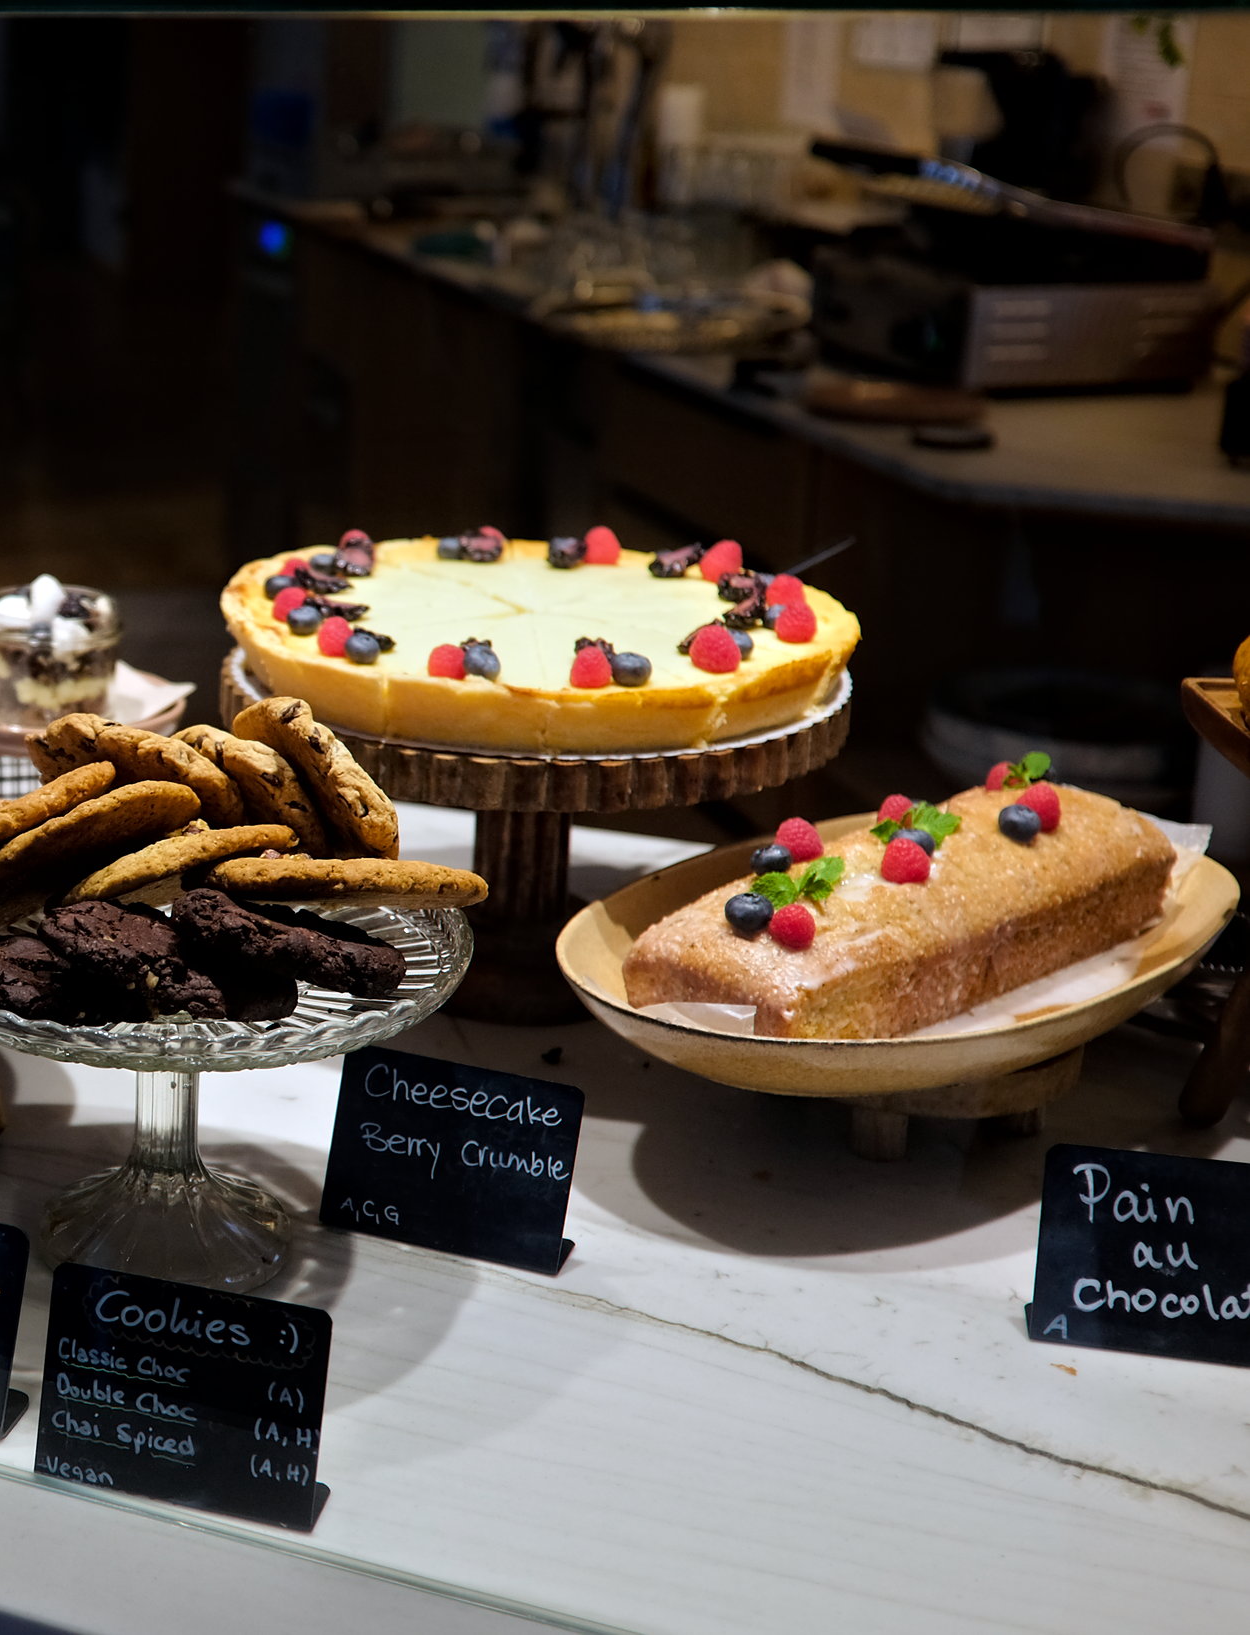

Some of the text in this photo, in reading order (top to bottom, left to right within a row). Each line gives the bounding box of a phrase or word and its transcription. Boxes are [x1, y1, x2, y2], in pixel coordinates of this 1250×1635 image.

[364, 1063, 563, 1127] Cheesecake
[359, 1122, 570, 1181] Berry Crumble
[1072, 1162, 1195, 1225] Pain
[1133, 1241, 1199, 1271] au
[95, 1290, 251, 1346] Cookies
[1042, 1313, 1068, 1340] A
[58, 1337, 191, 1383] Classic Choc
[56, 1372, 198, 1422] Double Choc
[51, 1411, 196, 1456] Chai Spiced
